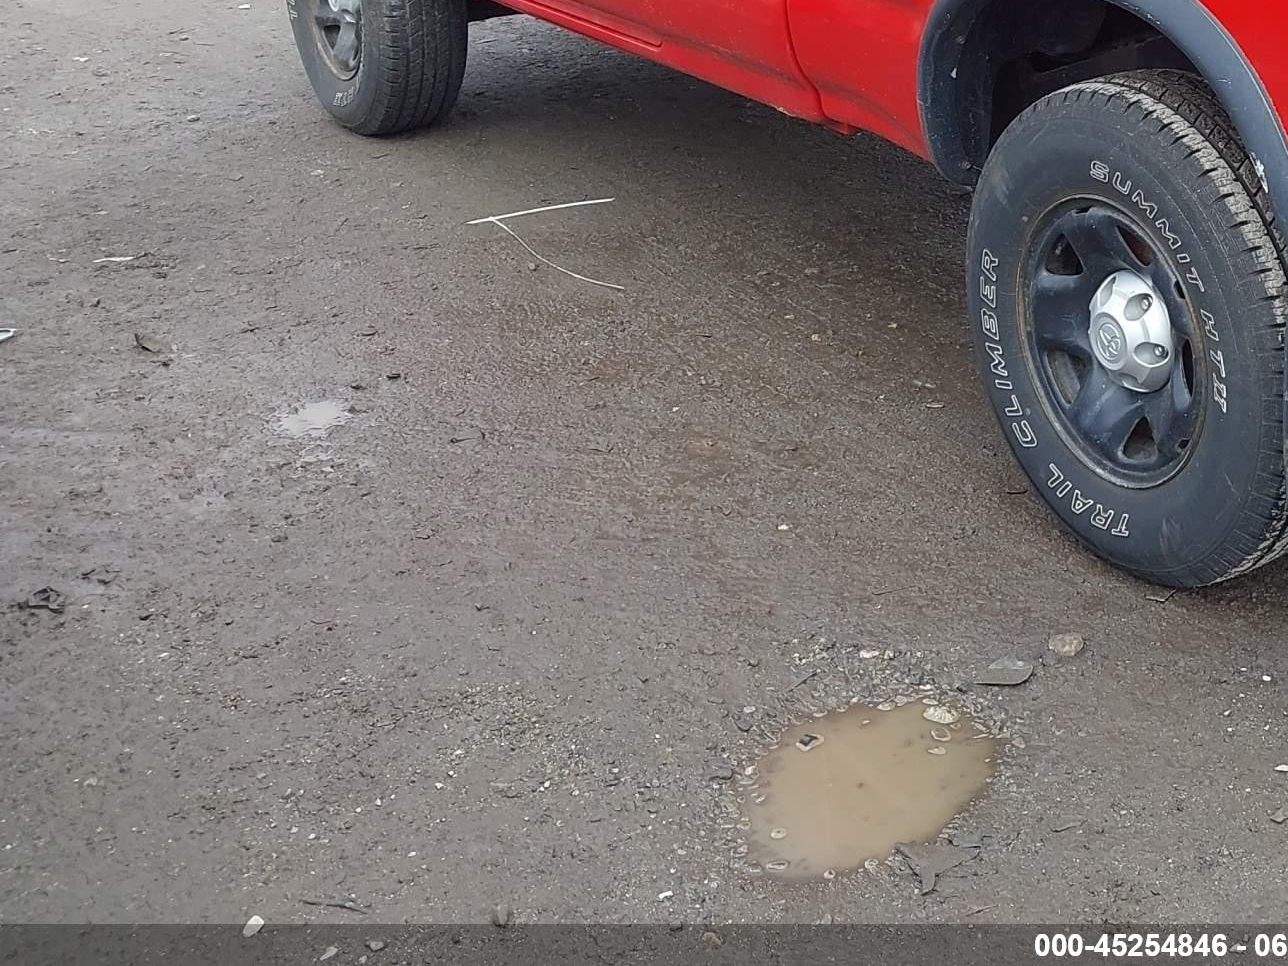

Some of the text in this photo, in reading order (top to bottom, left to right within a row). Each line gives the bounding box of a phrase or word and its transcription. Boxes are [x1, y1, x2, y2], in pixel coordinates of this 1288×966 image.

[1090, 160, 1205, 293] SUMMIT
[979, 248, 1130, 537] TRAIL CLIMBER
